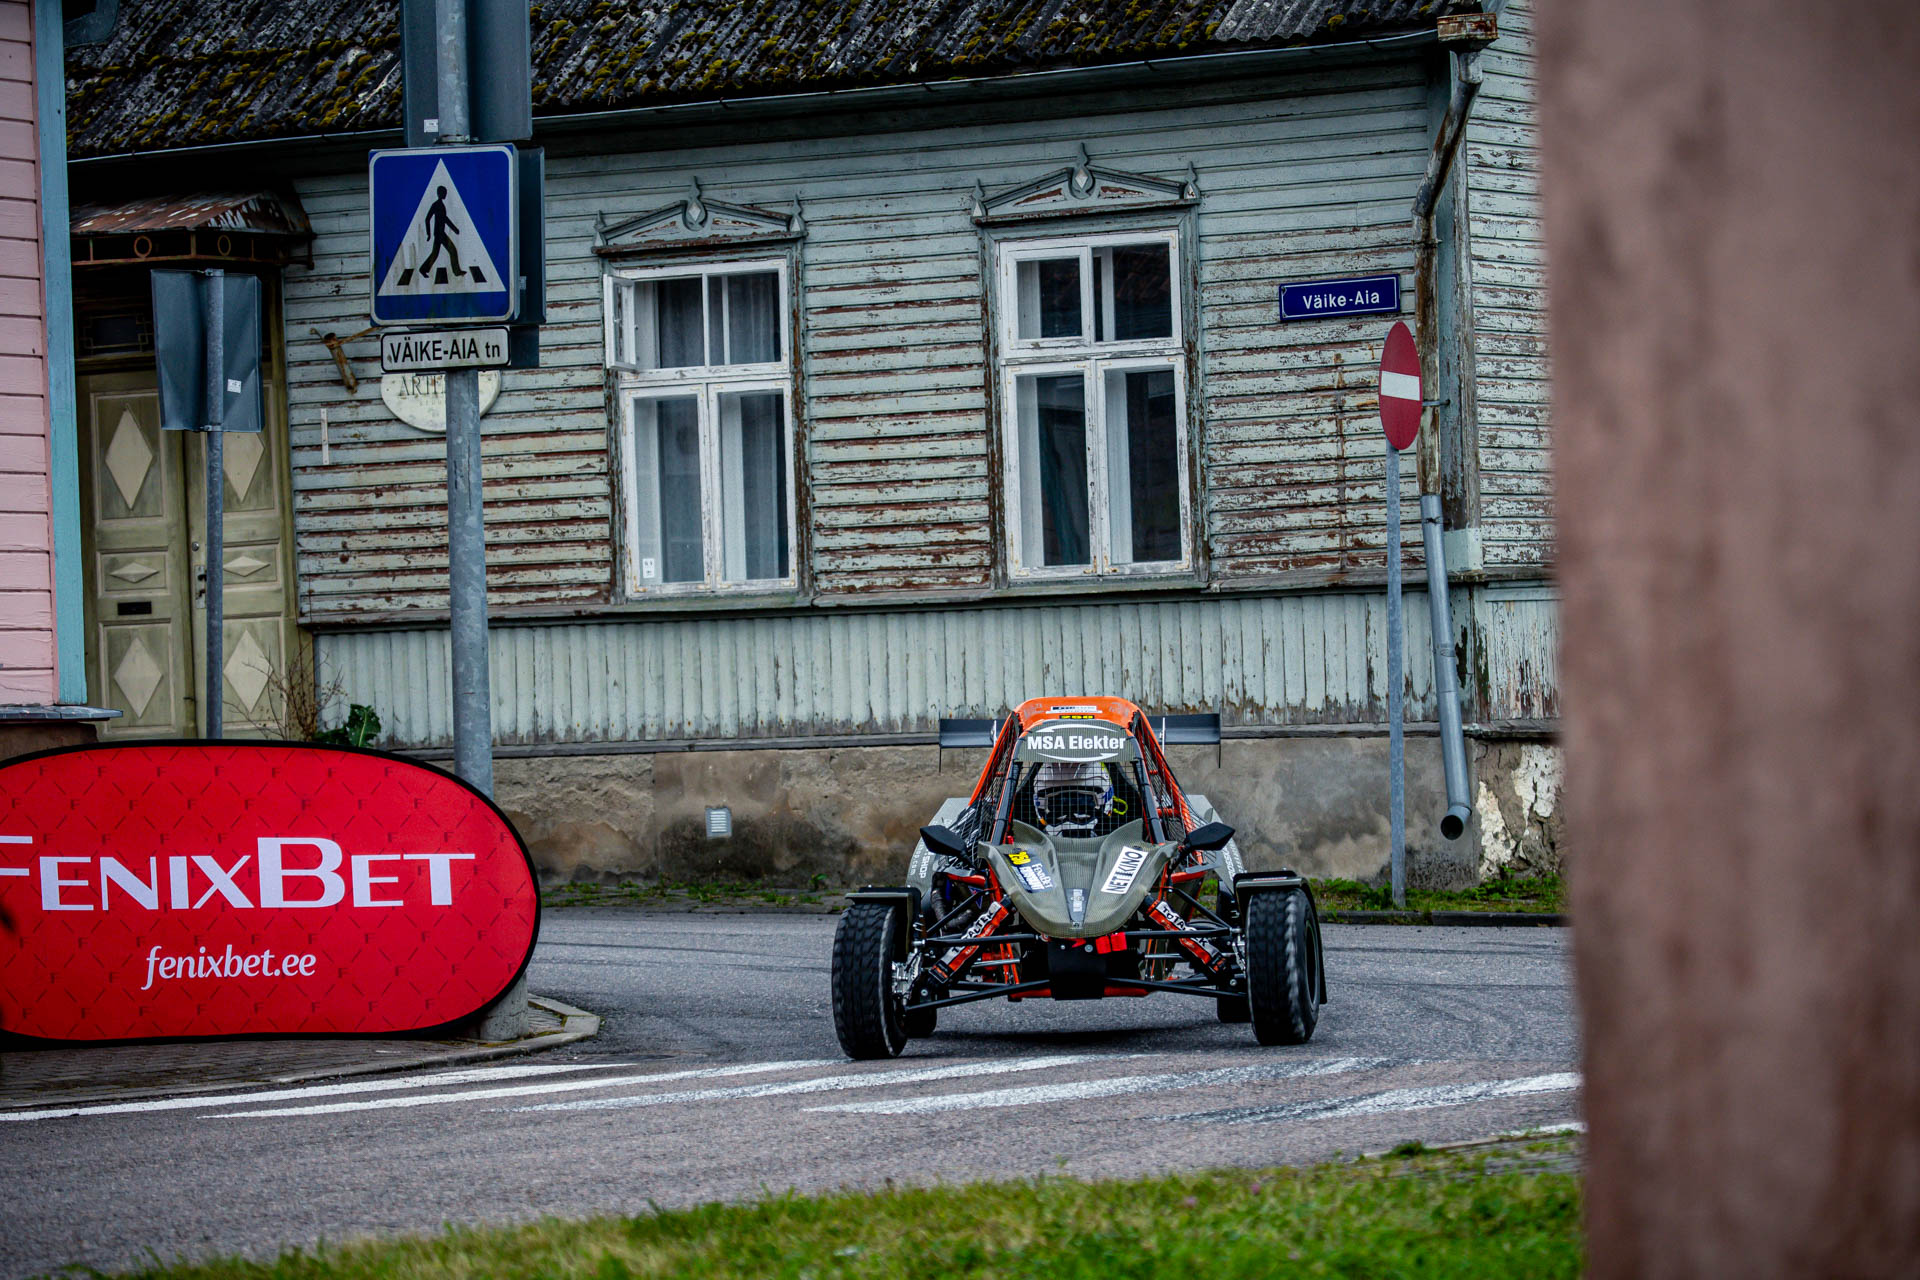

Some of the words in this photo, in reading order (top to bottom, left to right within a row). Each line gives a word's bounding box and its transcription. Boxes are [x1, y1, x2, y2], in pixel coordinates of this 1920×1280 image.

[1302, 290, 1380, 310] Väike-Aia
[390, 336, 479, 363] VÄIKE-AIA
[485, 342, 500, 358] tn
[1027, 735, 1065, 750] MSA
[1069, 735, 1126, 750] Elekter
[951, 911, 993, 954] TALTEK
[1163, 905, 1208, 947] TOTAK
[141, 944, 317, 990] fenixbet.ee
